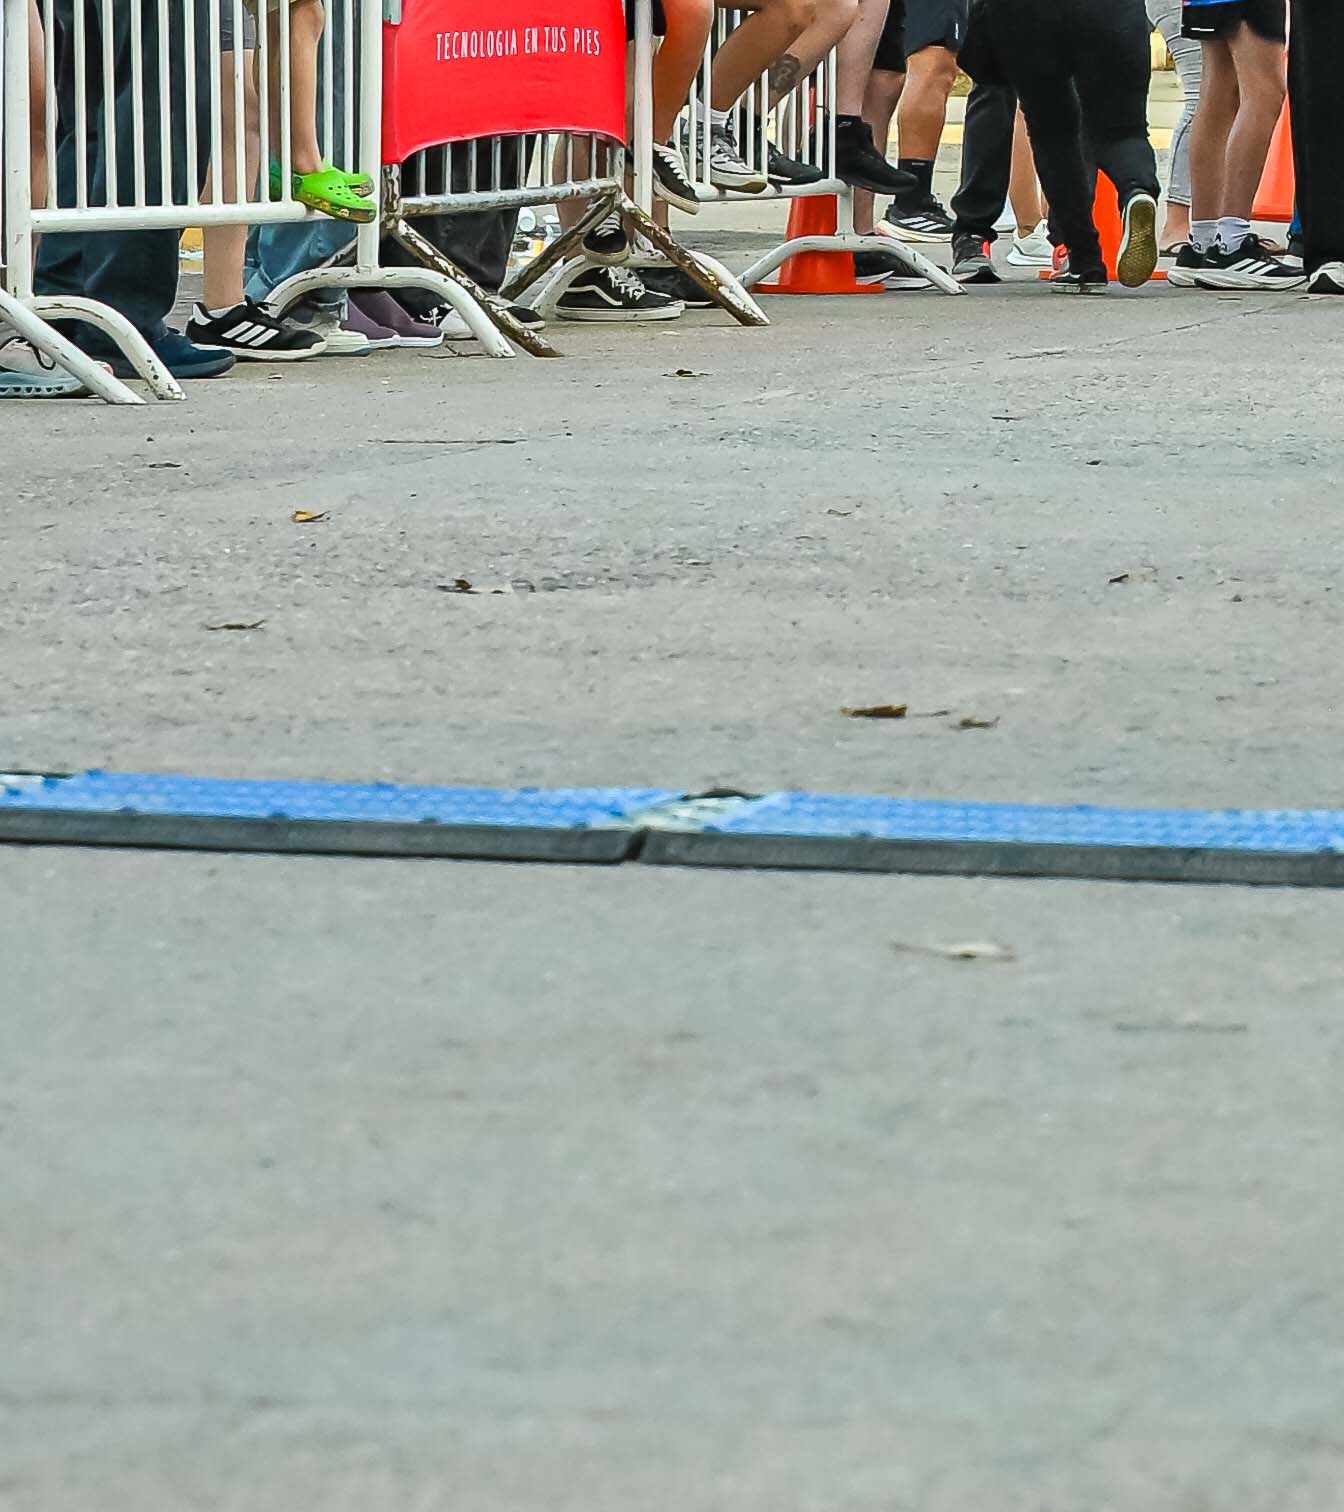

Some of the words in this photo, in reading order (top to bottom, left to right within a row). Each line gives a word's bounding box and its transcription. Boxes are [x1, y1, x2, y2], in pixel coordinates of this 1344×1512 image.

[436, 29, 517, 61] TECNOLOGIA
[525, 28, 538, 54] EN
[544, 26, 567, 53] TUS
[573, 27, 600, 56] PIES
